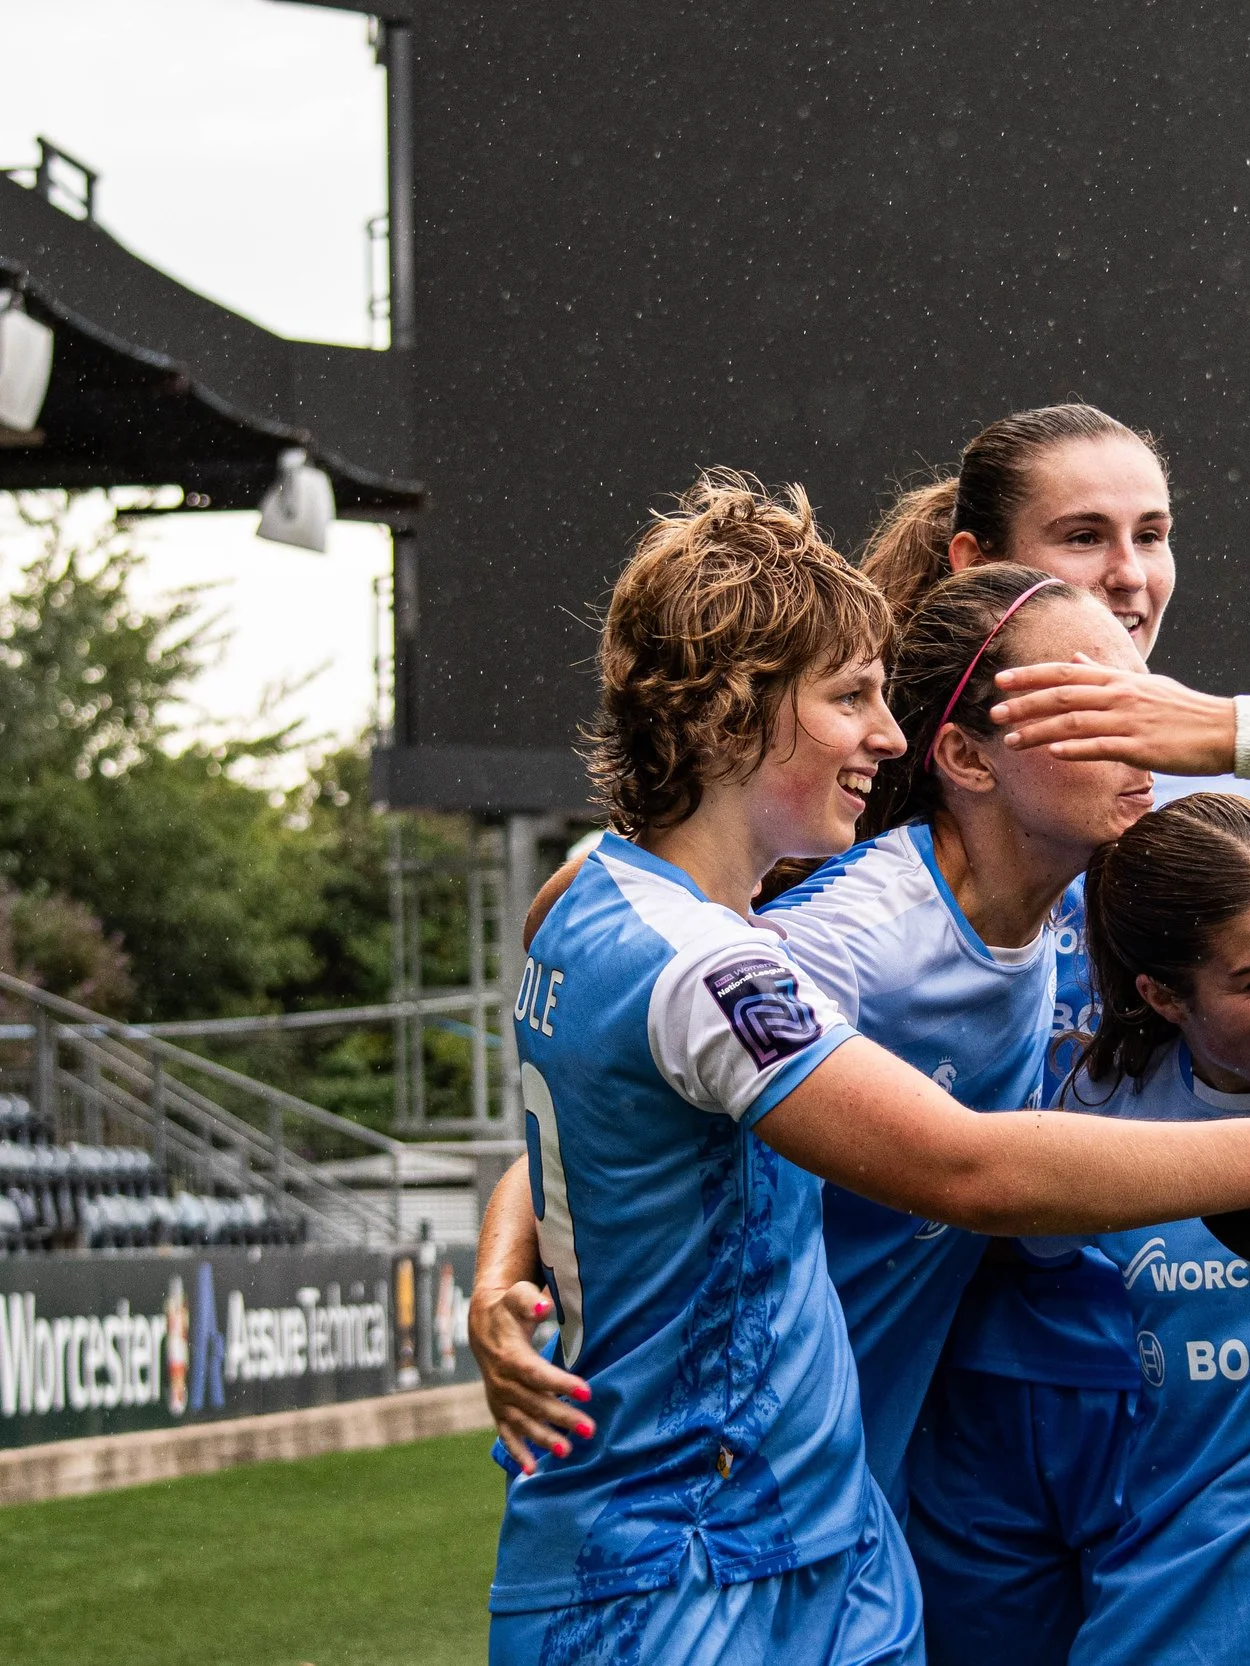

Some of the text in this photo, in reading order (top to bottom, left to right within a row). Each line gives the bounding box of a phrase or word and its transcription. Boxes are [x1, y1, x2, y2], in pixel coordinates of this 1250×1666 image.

[514, 956, 565, 1038] OLE
[717, 967, 786, 998] National League
[0, 1290, 166, 1417] Worcester
